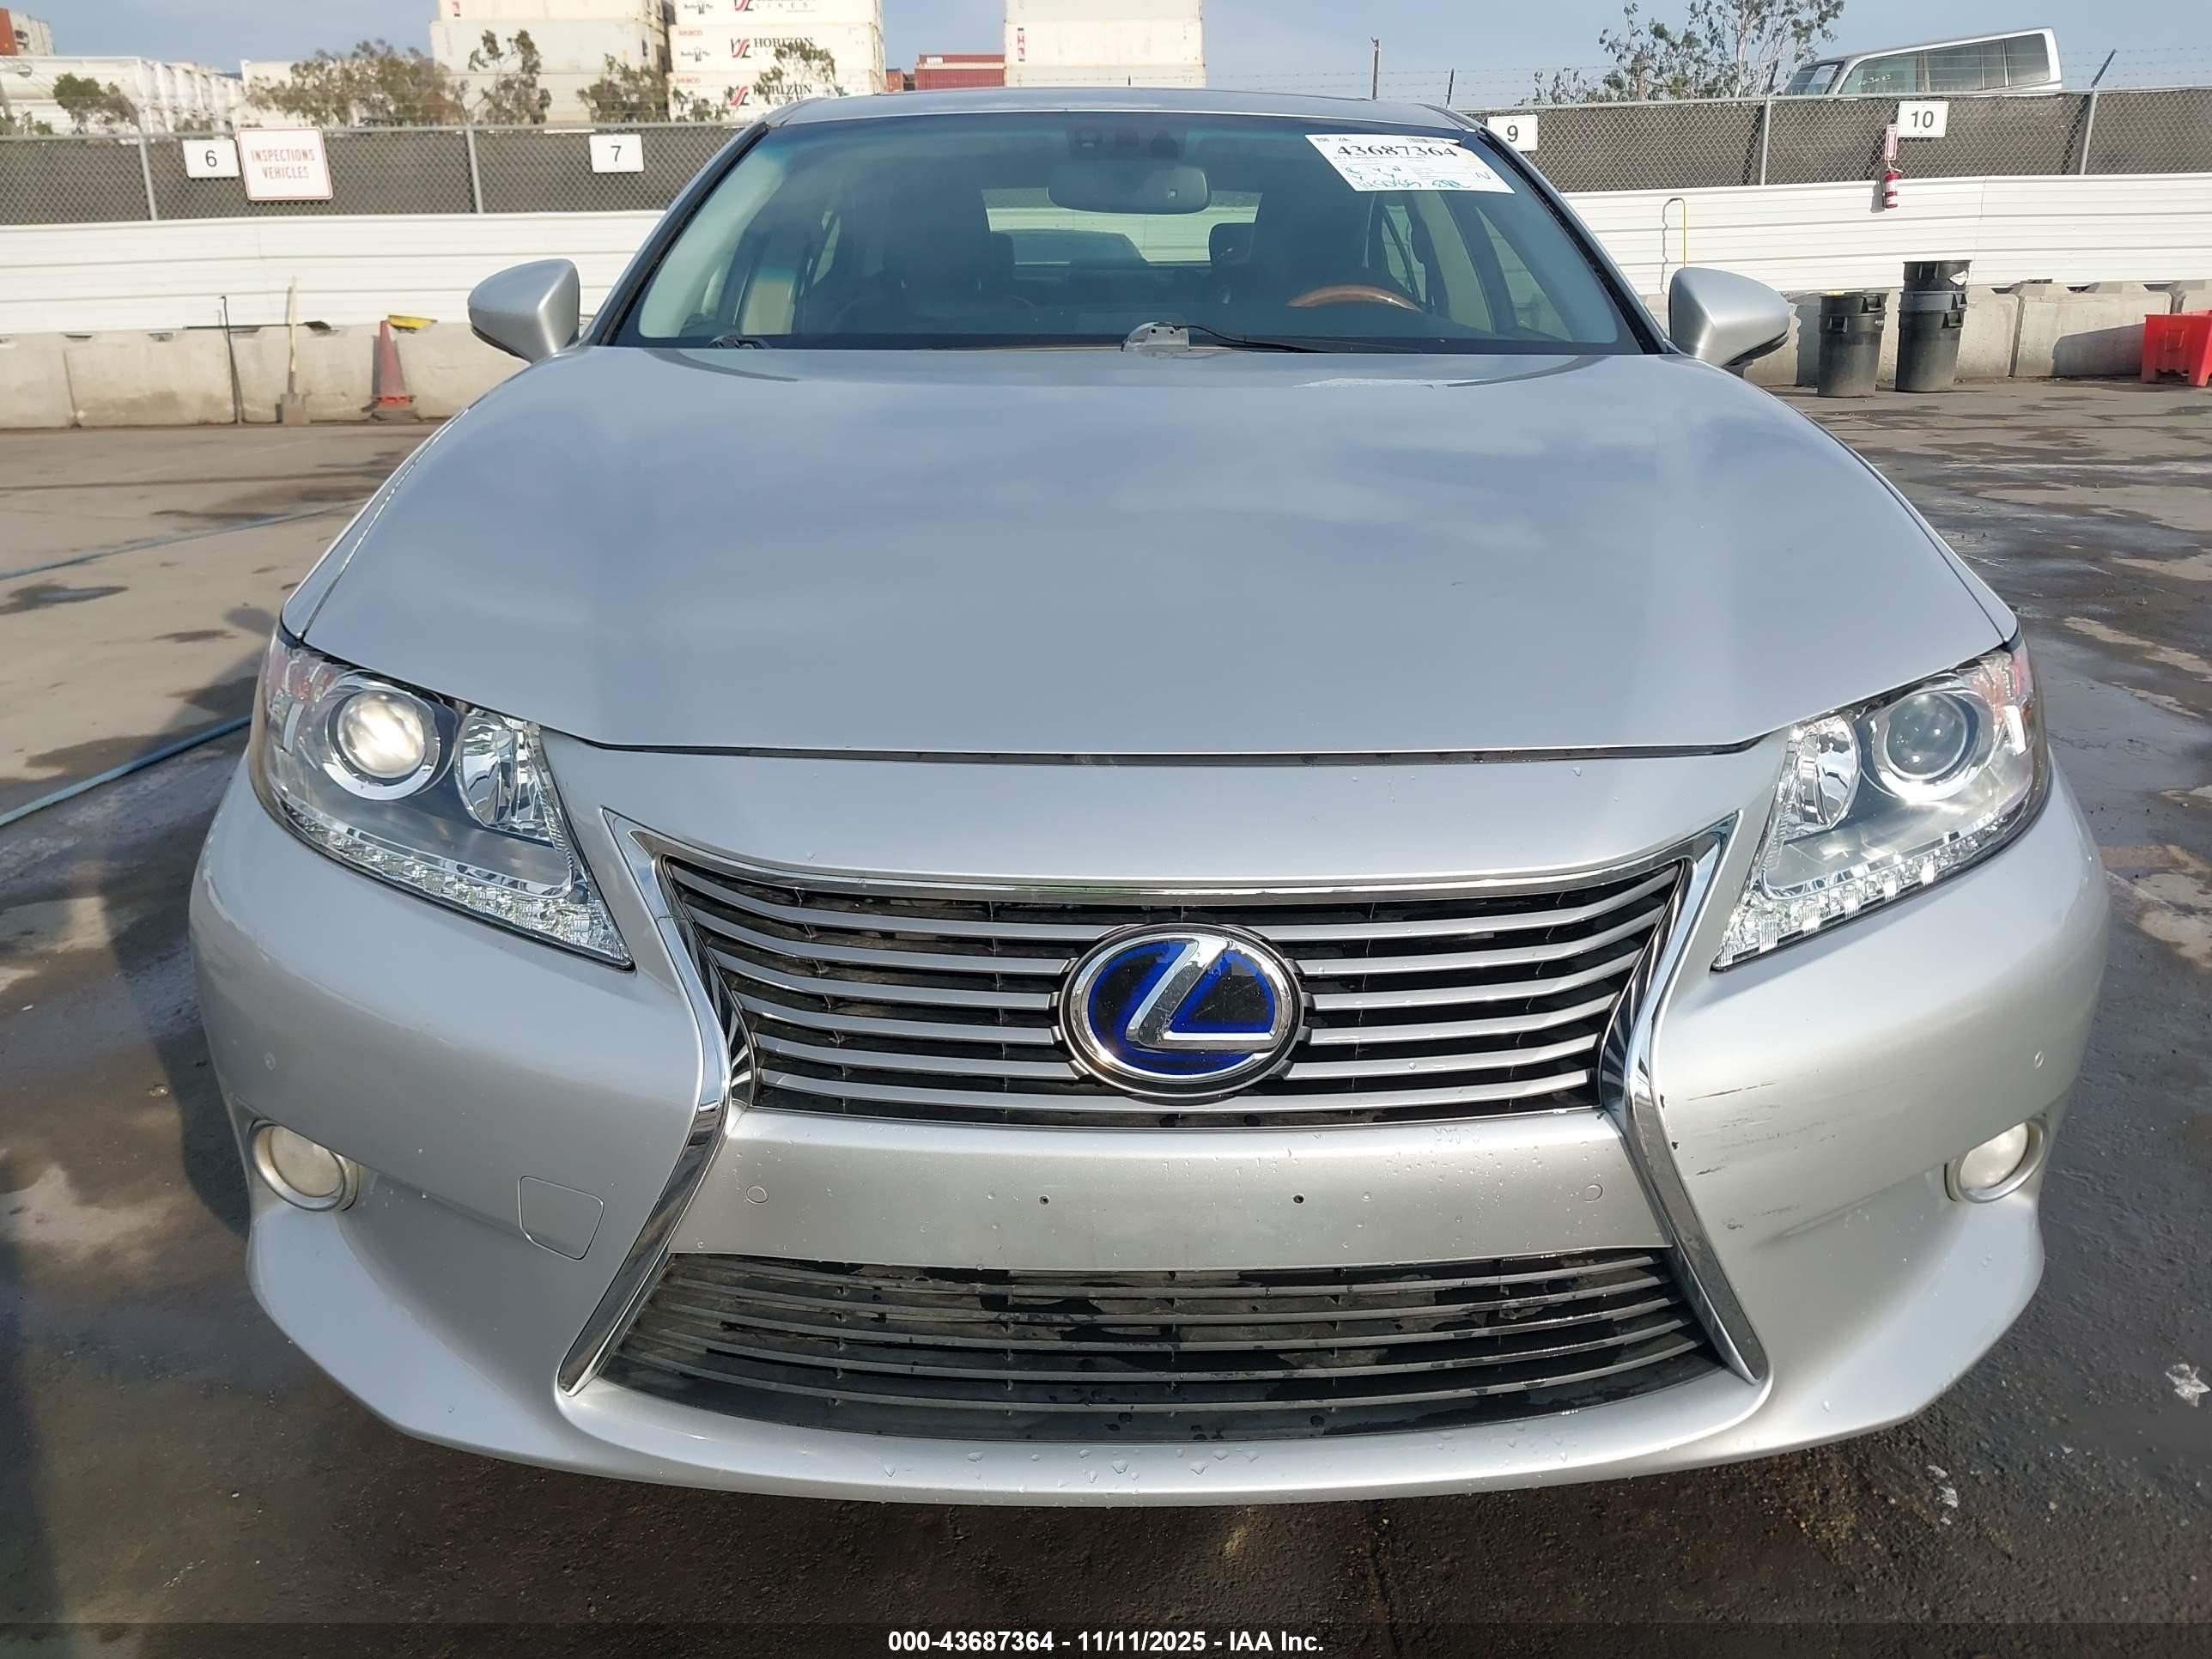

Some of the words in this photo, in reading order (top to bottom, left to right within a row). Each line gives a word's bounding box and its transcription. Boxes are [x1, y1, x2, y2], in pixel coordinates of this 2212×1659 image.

[1911, 110, 1935, 129] 10
[1506, 125, 1519, 143] 9
[205, 149, 217, 167] 6
[251, 149, 316, 162] INSPECTIONS
[611, 145, 622, 162] 7
[1337, 144, 1458, 157] 43687364
[262, 166, 310, 179] VEHICLES
